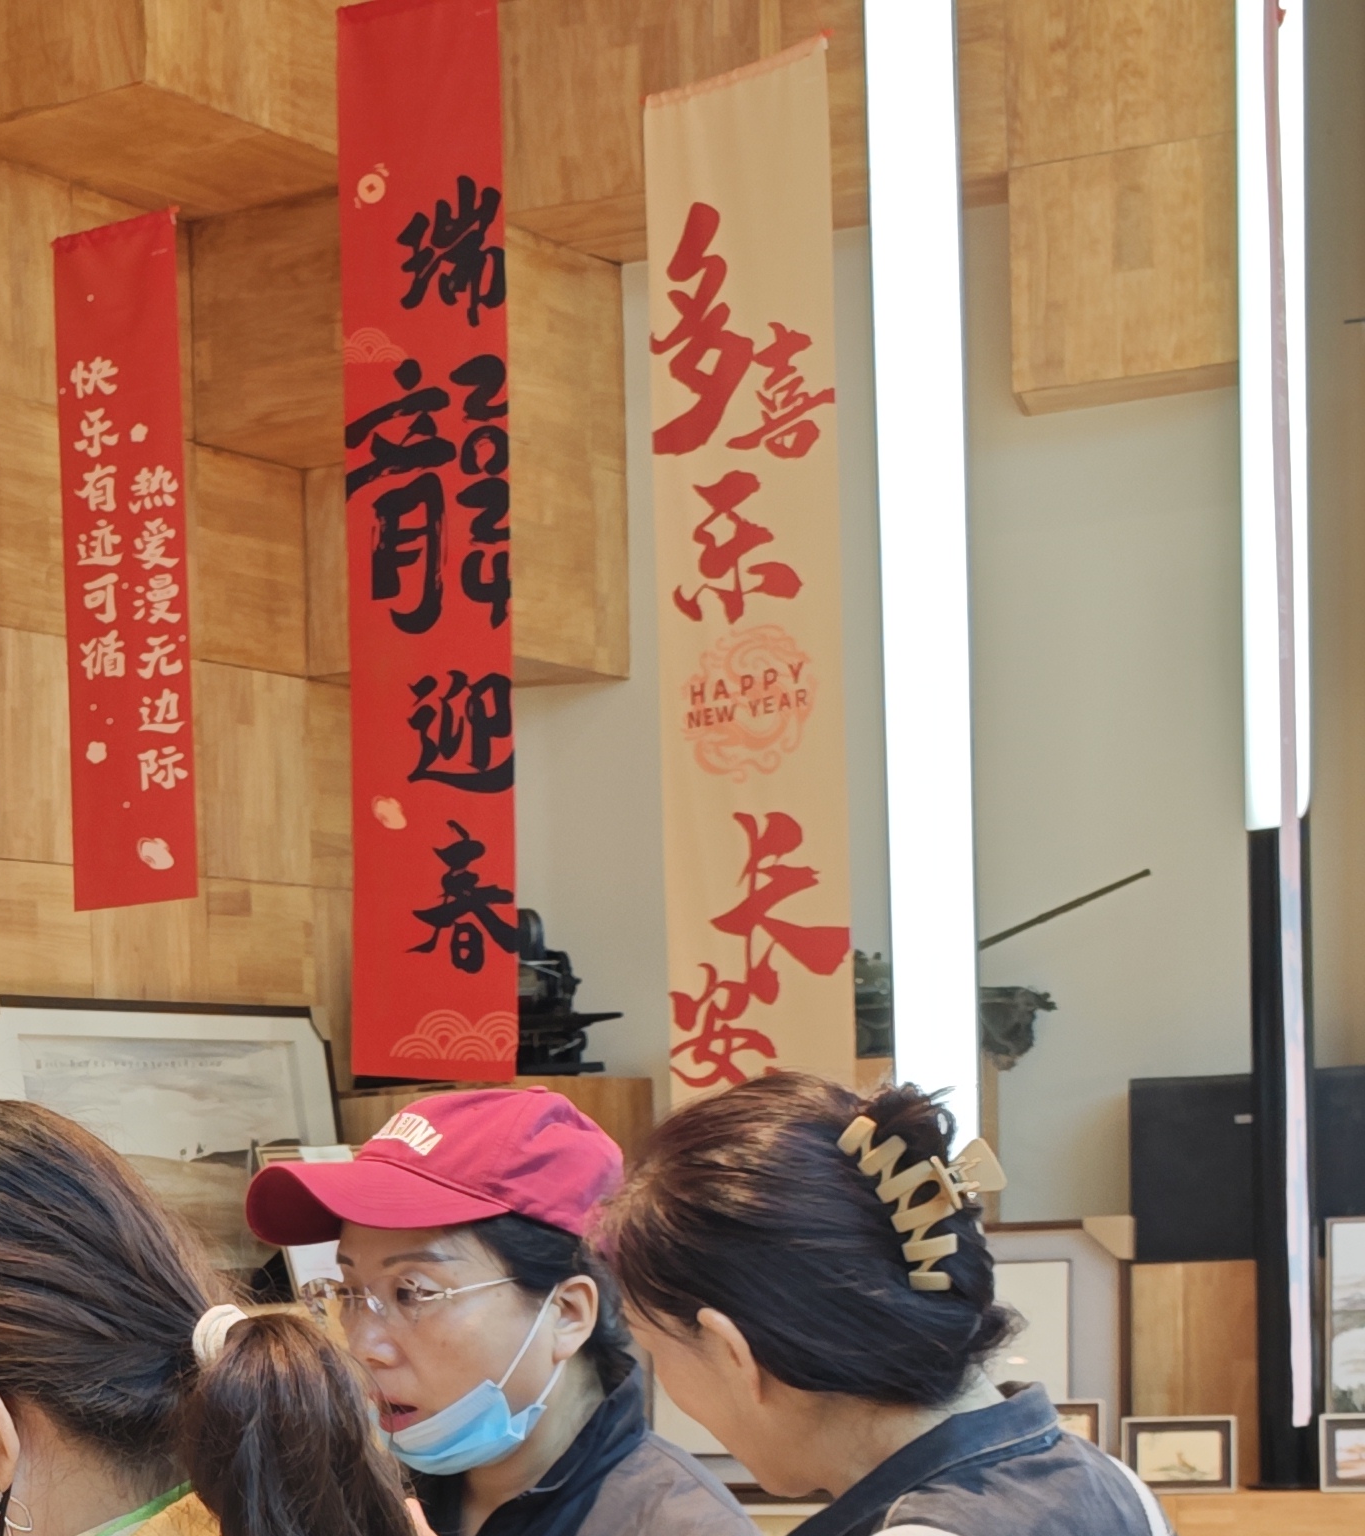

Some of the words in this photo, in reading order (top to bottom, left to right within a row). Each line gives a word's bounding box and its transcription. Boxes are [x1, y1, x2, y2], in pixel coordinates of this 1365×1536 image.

[70, 356, 126, 680] 快乐有迹可循
[127, 465, 188, 791] 热爱漫无边际
[686, 703, 736, 730] NEW
[747, 688, 809, 718] YEAR
[689, 661, 806, 706] HAPPY
